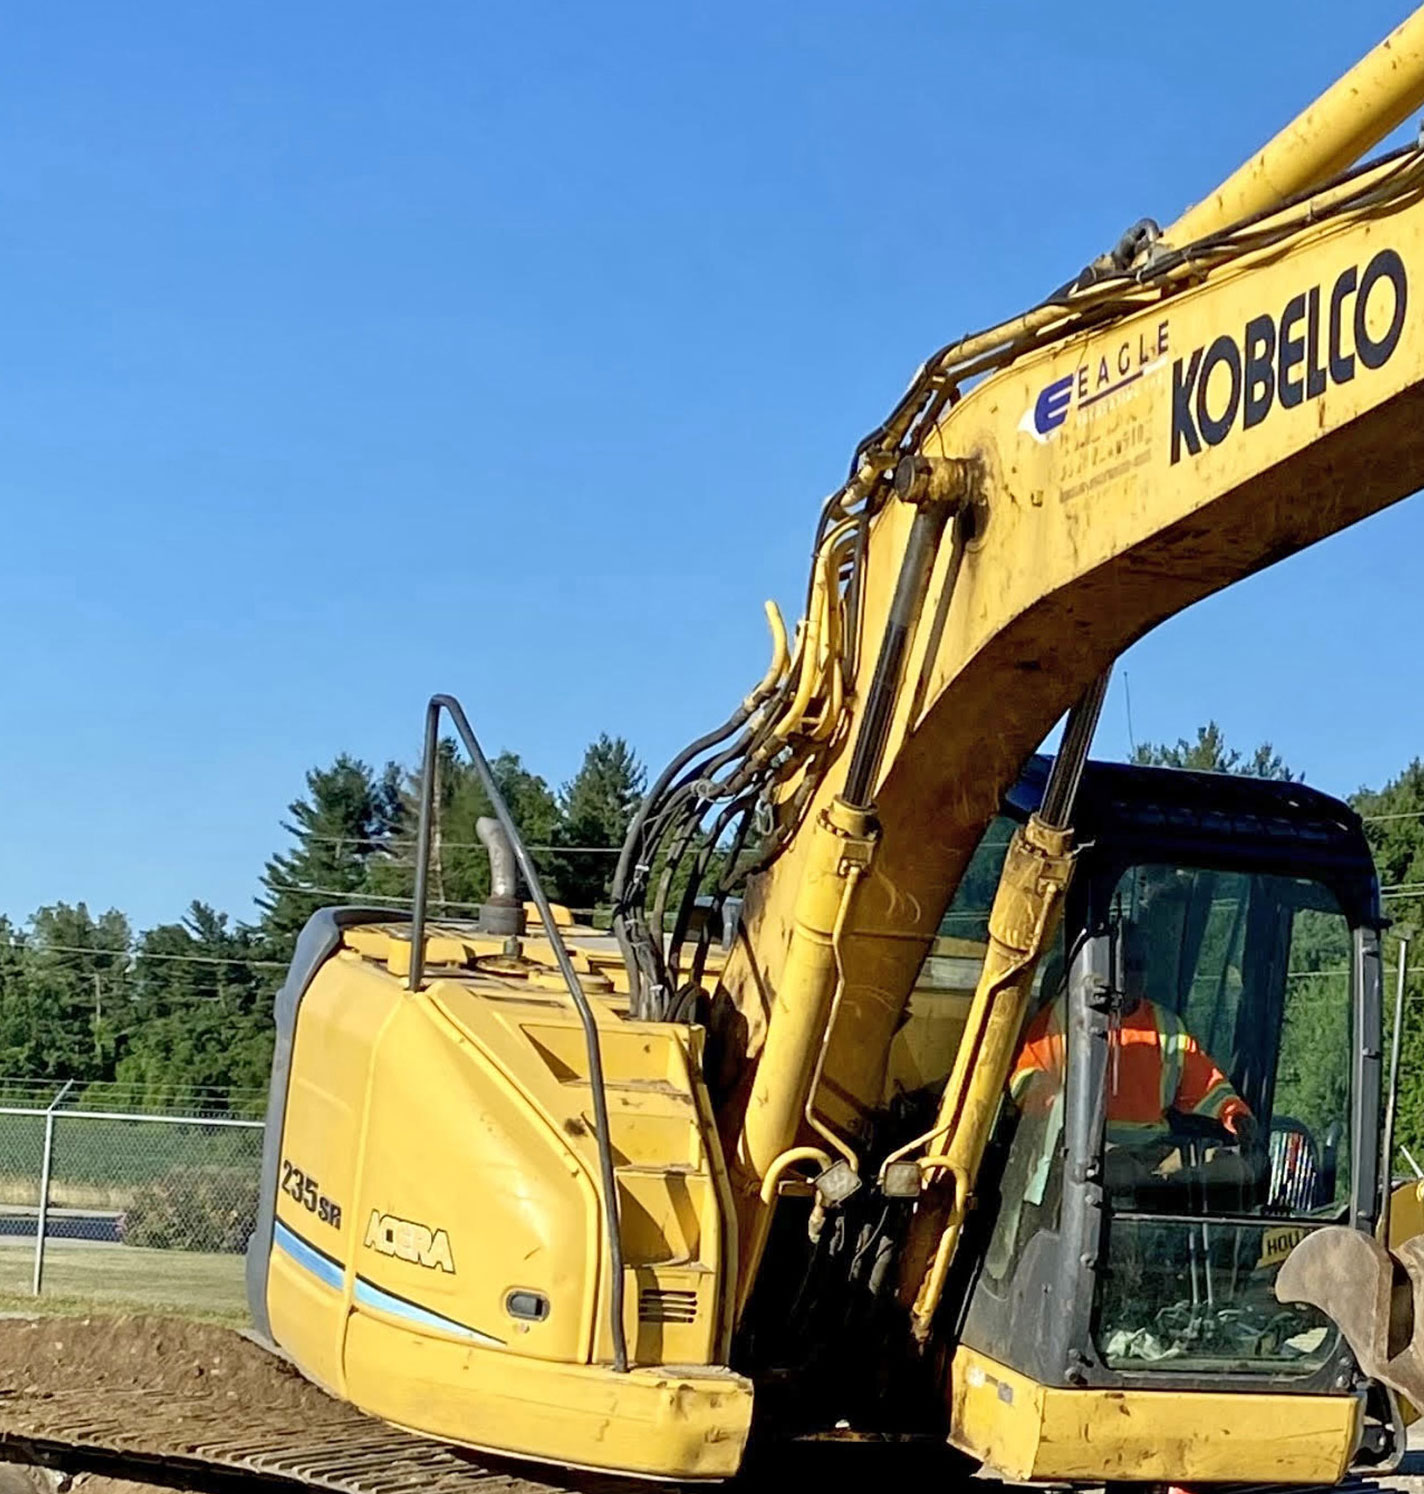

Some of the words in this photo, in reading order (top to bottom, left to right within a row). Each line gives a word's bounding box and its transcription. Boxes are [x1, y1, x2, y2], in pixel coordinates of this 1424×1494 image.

[1077, 320, 1169, 399] EAGLE
[1170, 248, 1408, 466] KOBELCO
[363, 1208, 457, 1275] ACERA
